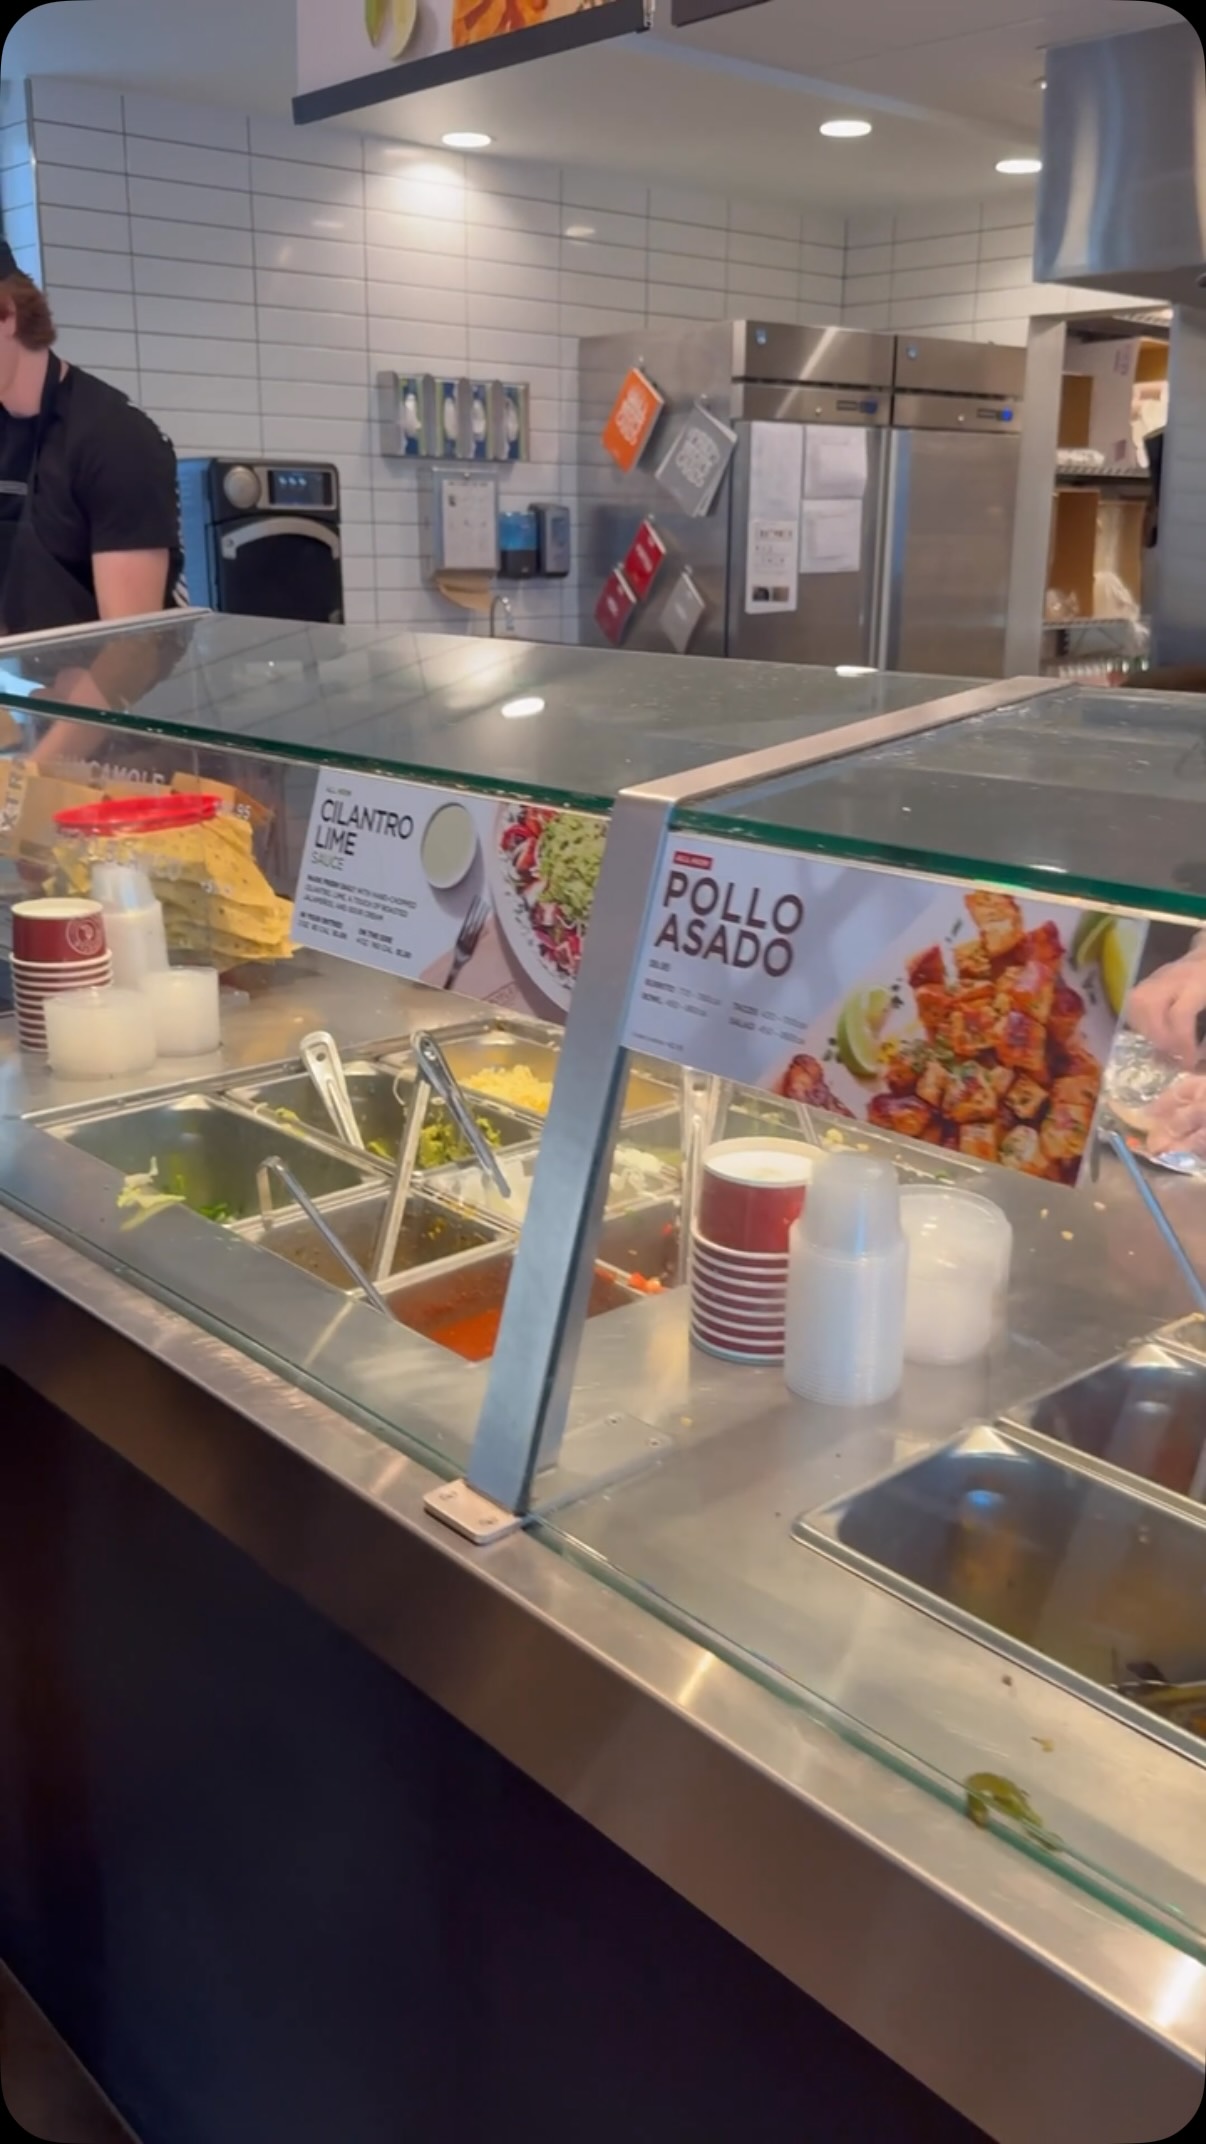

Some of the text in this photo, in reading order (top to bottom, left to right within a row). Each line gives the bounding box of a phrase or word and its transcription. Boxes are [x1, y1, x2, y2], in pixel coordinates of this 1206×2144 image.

[320, 798, 414, 840] CILANTRO
[311, 851, 345, 871] SAUCE
[314, 825, 358, 856] LIME
[662, 870, 804, 935] POLLO
[654, 913, 794, 978] ASADO
